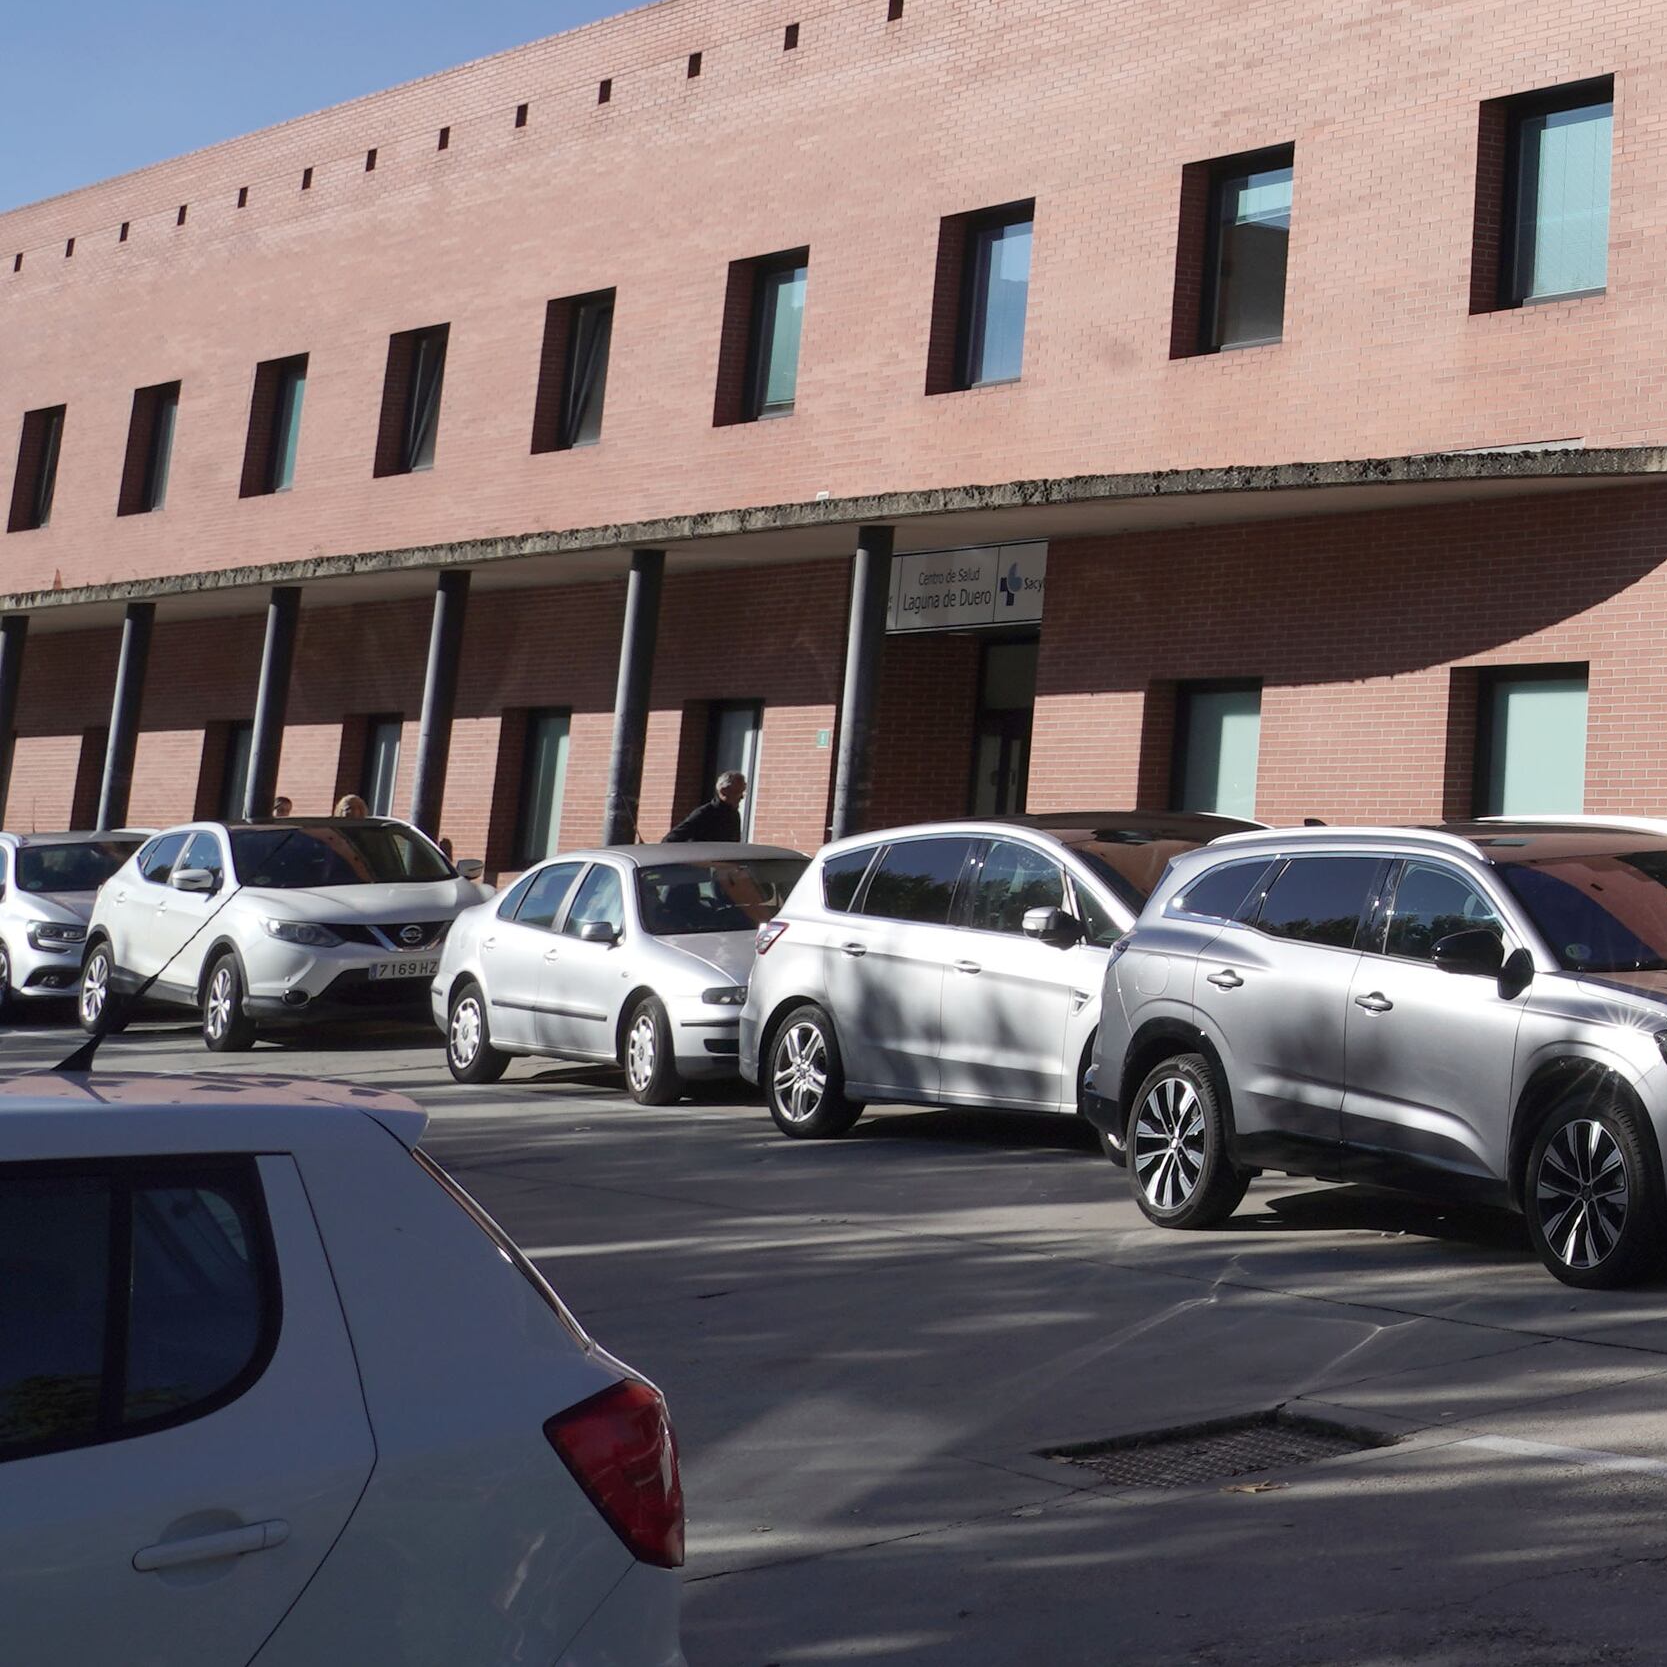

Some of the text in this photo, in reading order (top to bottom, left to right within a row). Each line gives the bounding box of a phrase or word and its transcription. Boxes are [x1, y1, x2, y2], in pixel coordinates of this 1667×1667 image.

[918, 567, 980, 586] Centro de Salud
[1024, 577, 1045, 593] Sacy
[903, 593, 939, 614] Laguna
[943, 590, 956, 608] de
[959, 588, 992, 607] Duero
[379, 961, 438, 977] 7169 HZ
